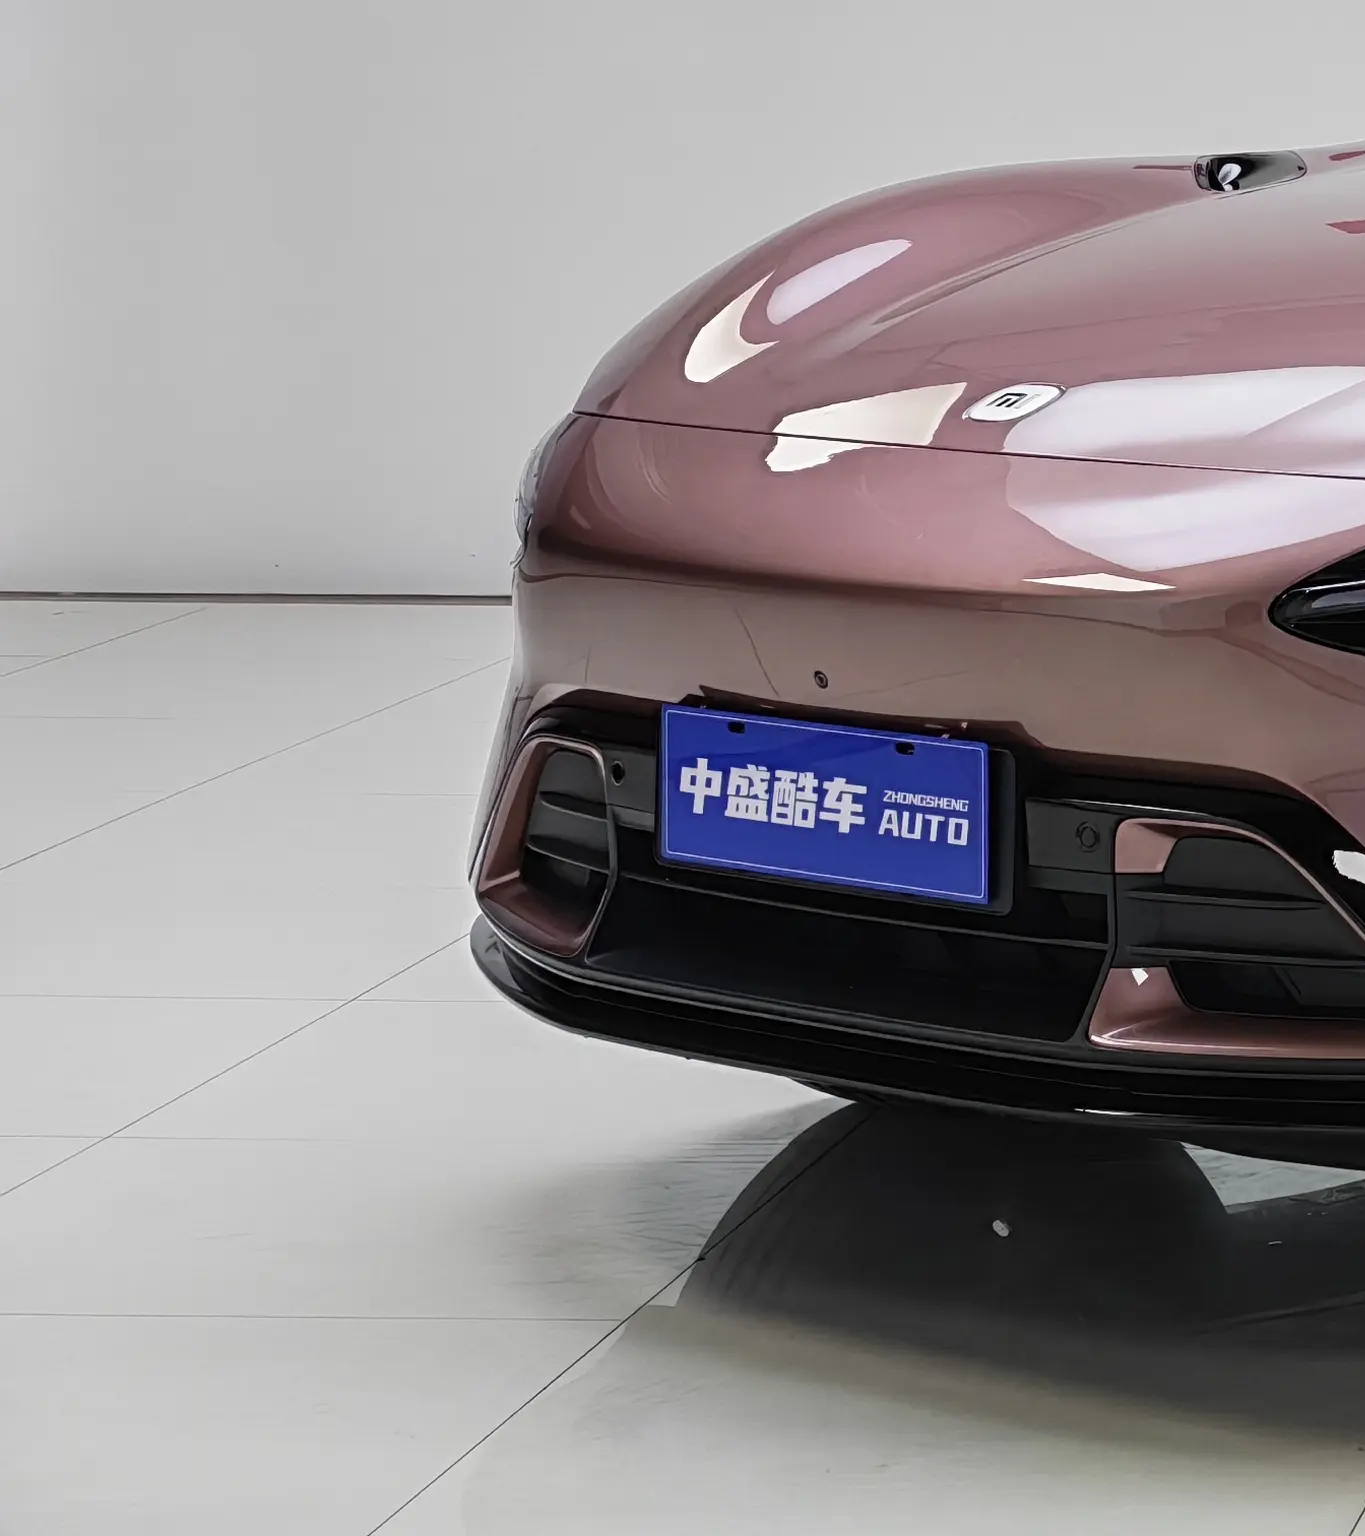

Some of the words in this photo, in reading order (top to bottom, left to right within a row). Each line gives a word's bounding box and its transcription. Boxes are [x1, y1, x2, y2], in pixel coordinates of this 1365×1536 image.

[679, 757, 867, 834] 中盛酷车
[883, 790, 969, 813] ZHONGSHENG
[878, 809, 969, 846] AUTO
